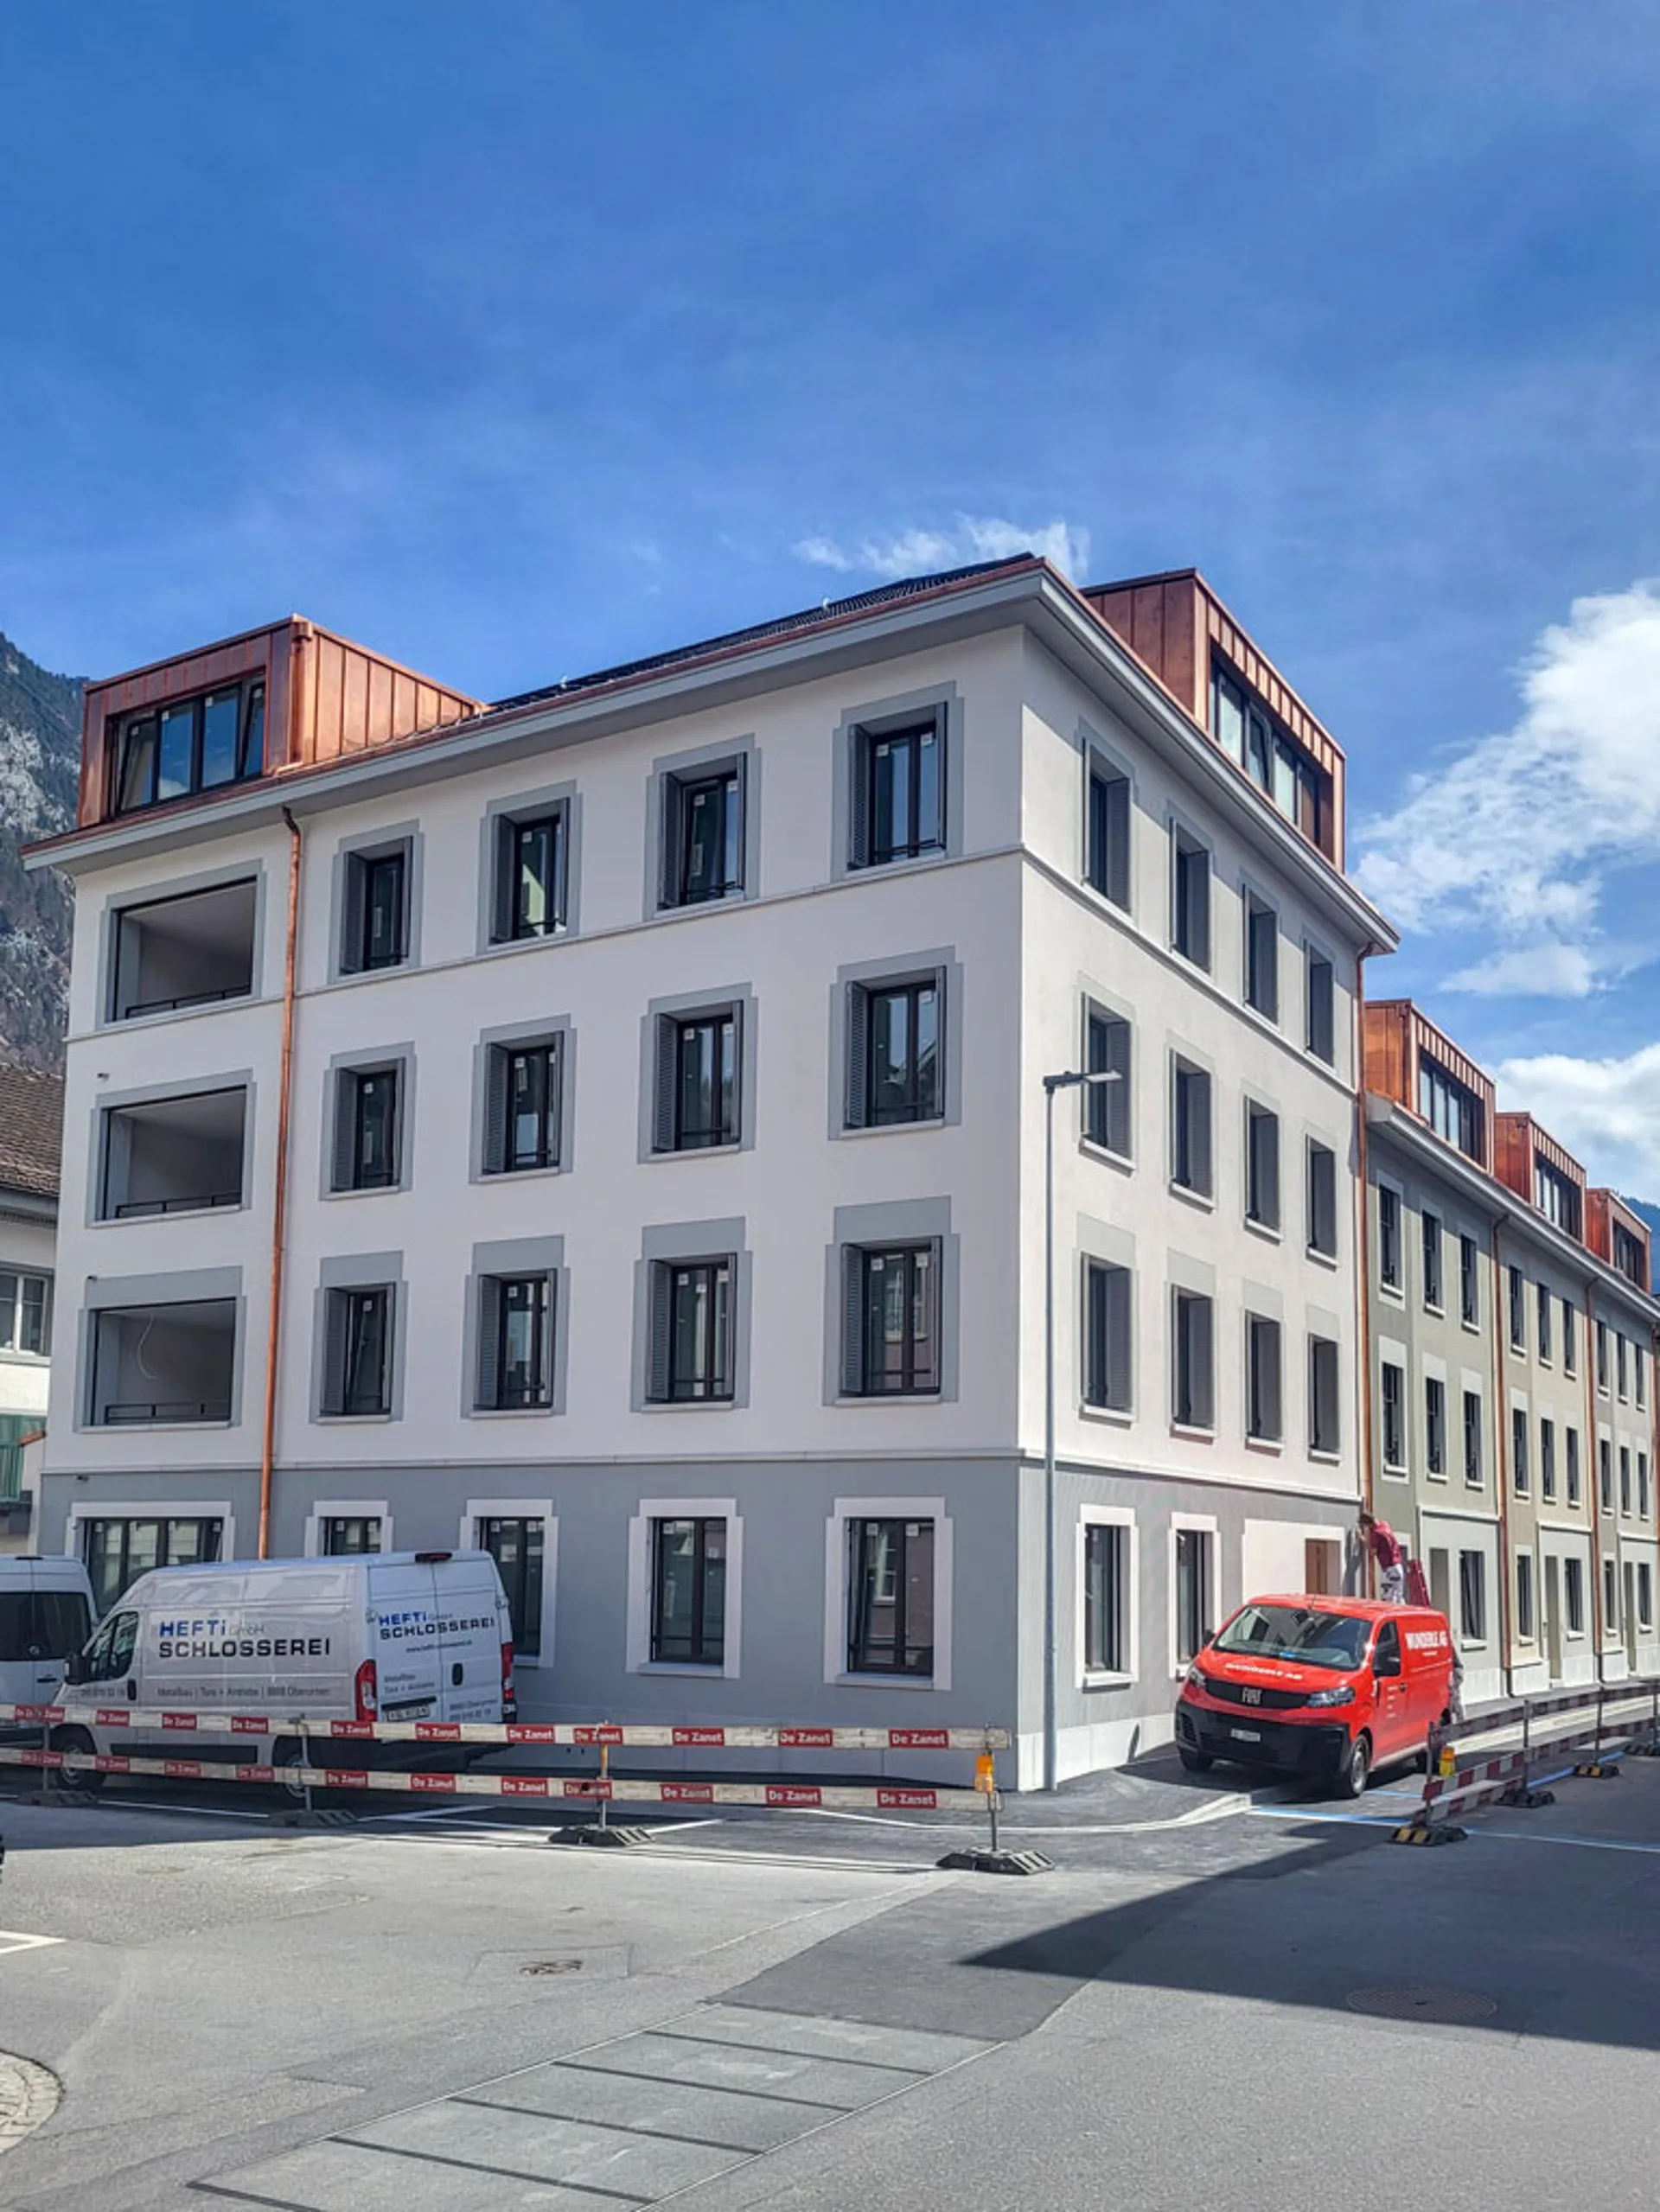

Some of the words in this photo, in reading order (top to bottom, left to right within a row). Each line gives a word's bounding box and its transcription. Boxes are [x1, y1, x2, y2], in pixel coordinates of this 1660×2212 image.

[380, 1617, 495, 1640] SCHLOSSEREI
[159, 1639, 330, 1658] SCHLOSSEREI
[675, 1731, 688, 1742] De
[892, 1733, 909, 1744] De
[911, 1734, 946, 1745] Zanet
[881, 1793, 897, 1804] De
[899, 1794, 934, 1805] Zanet
